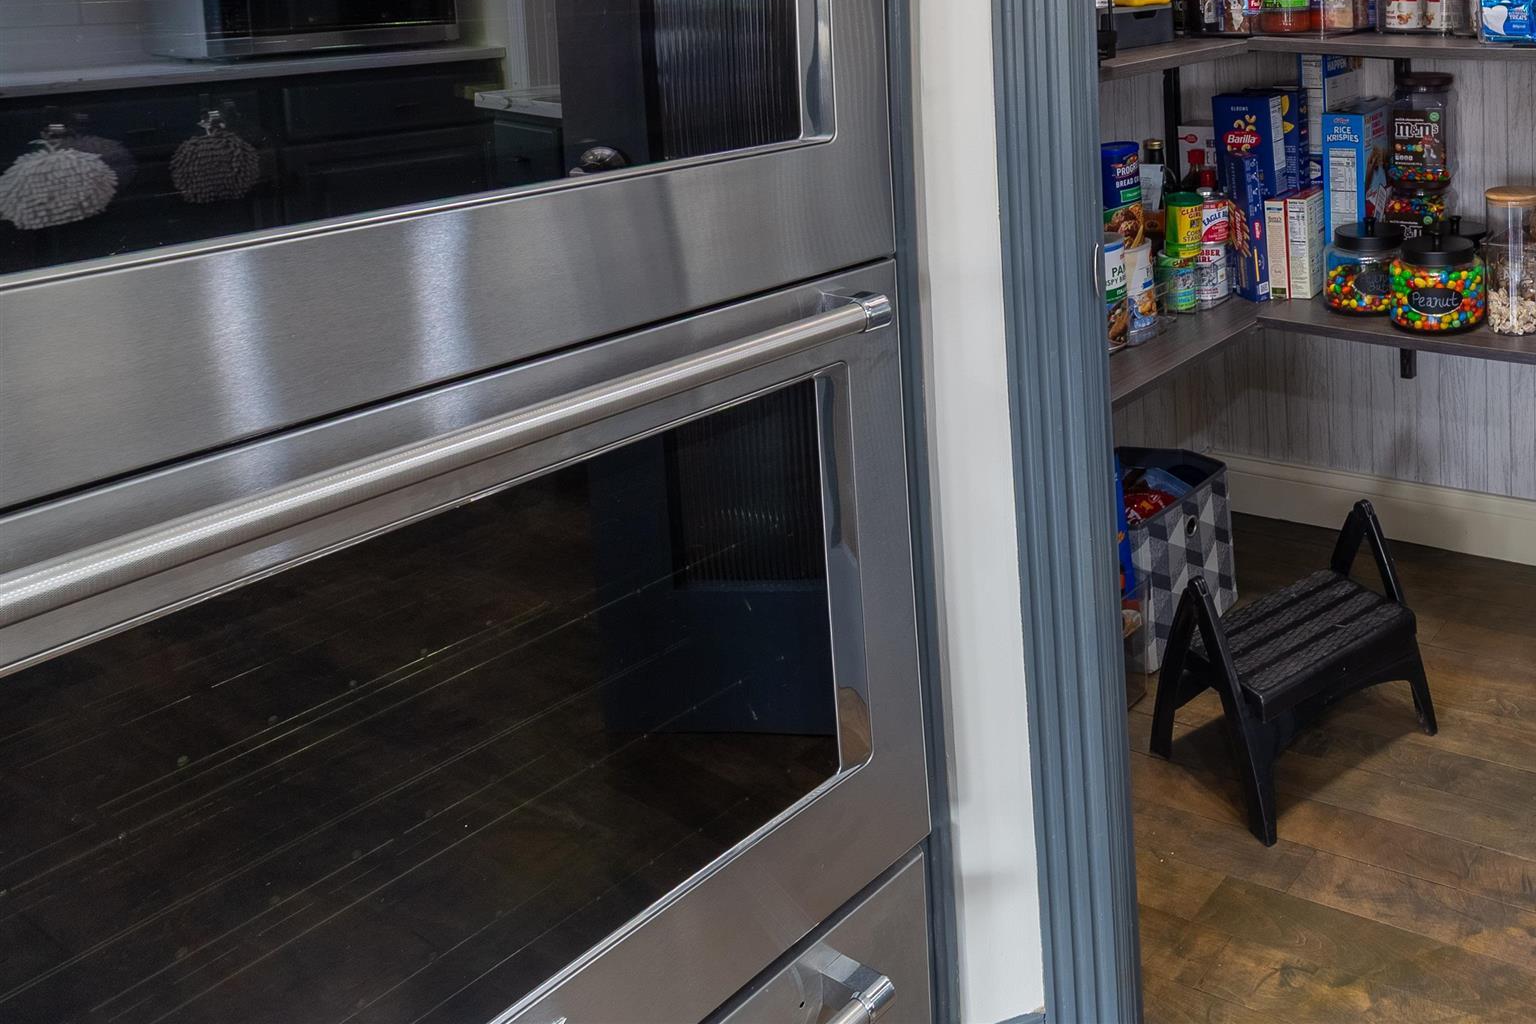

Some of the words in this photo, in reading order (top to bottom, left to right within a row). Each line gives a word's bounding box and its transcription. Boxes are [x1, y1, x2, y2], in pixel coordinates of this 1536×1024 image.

[1333, 126, 1351, 134] RICE
[1226, 134, 1256, 144] Barilla
[1326, 134, 1359, 143] KRISPIES
[1115, 178, 1133, 189] BREAD
[1202, 211, 1221, 227] EAGLE
[1411, 291, 1459, 308] Peanut
